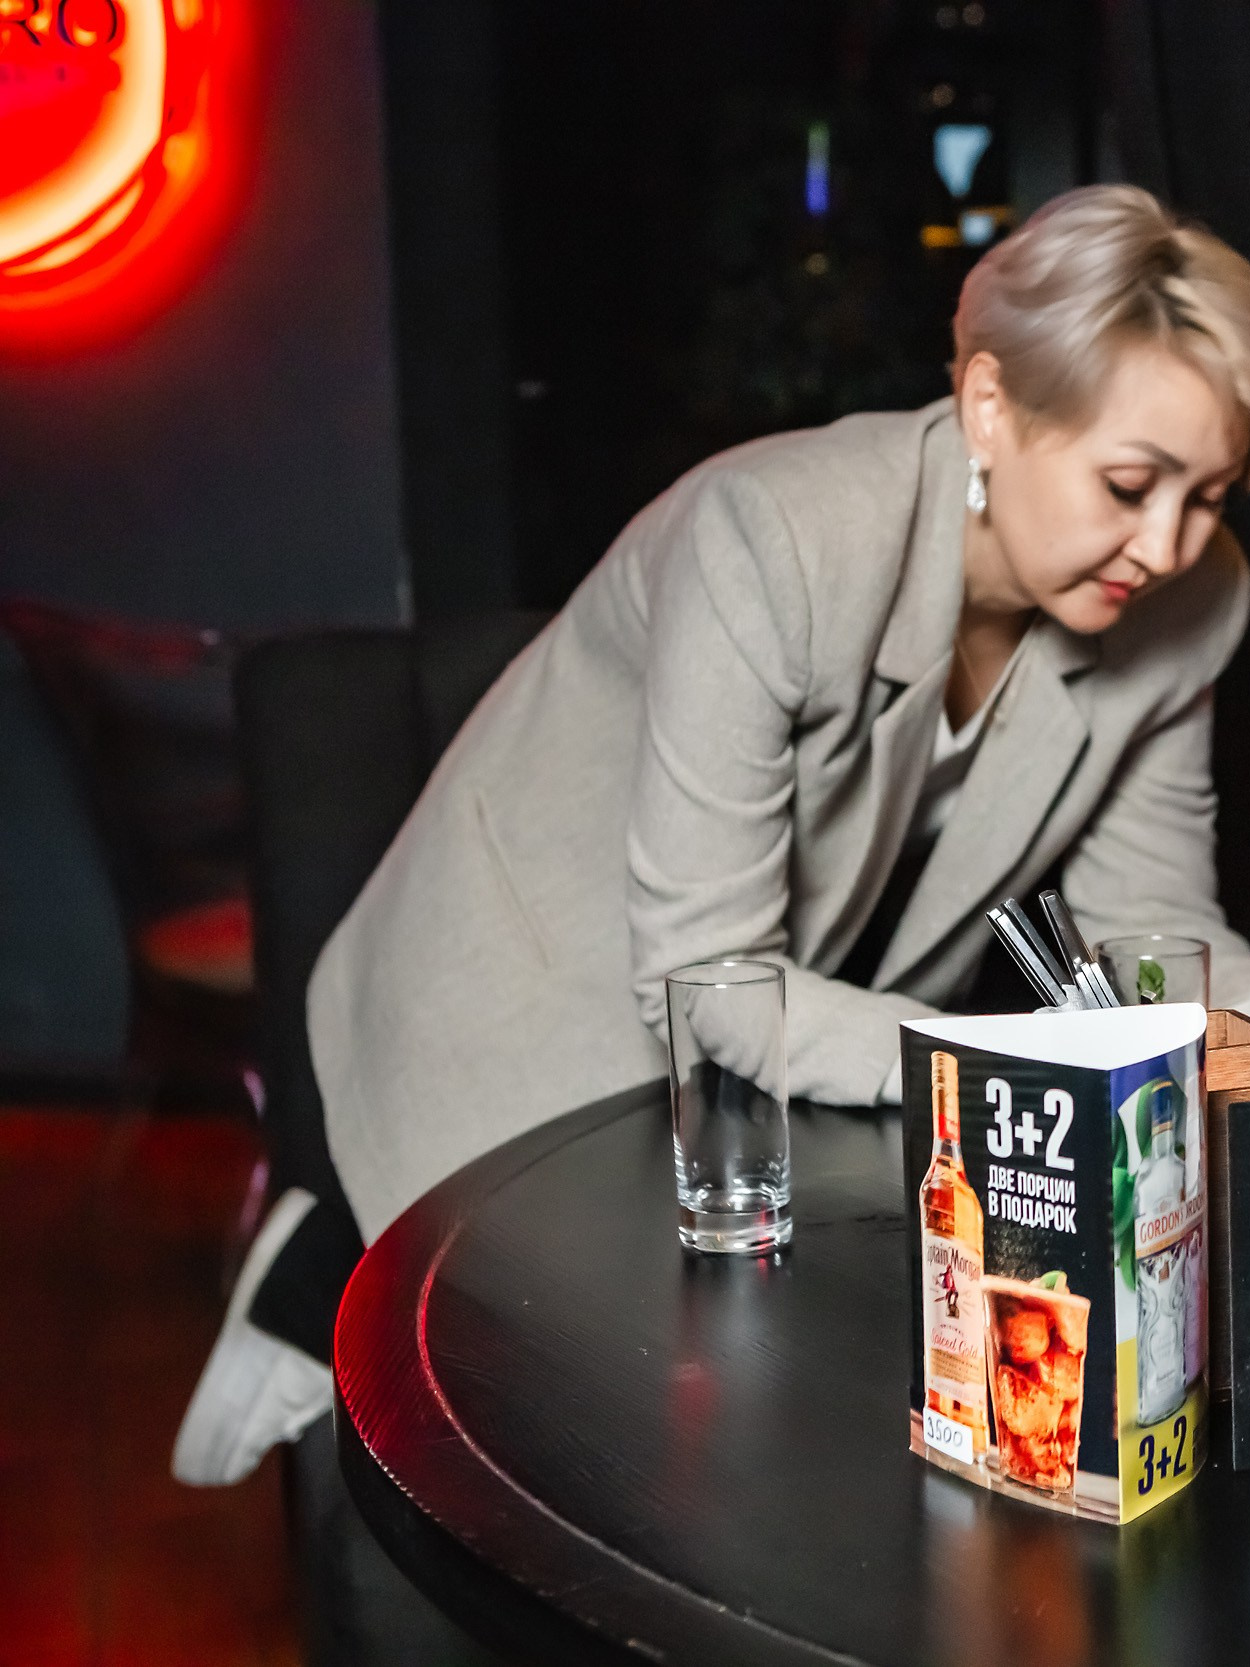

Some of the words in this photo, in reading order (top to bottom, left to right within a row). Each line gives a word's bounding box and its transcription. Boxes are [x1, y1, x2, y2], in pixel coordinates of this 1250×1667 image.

[986, 1077, 1075, 1173] 3+2
[988, 1164, 1016, 1192] ДВЕ
[1017, 1171, 1076, 1205] ПОРЦИИ
[988, 1190, 999, 1217] В
[1001, 1193, 1077, 1235] ПОДАРОК
[959, 1341, 979, 1360] Gold
[926, 1416, 964, 1447] 3500
[1138, 1415, 1187, 1496] 3+2
